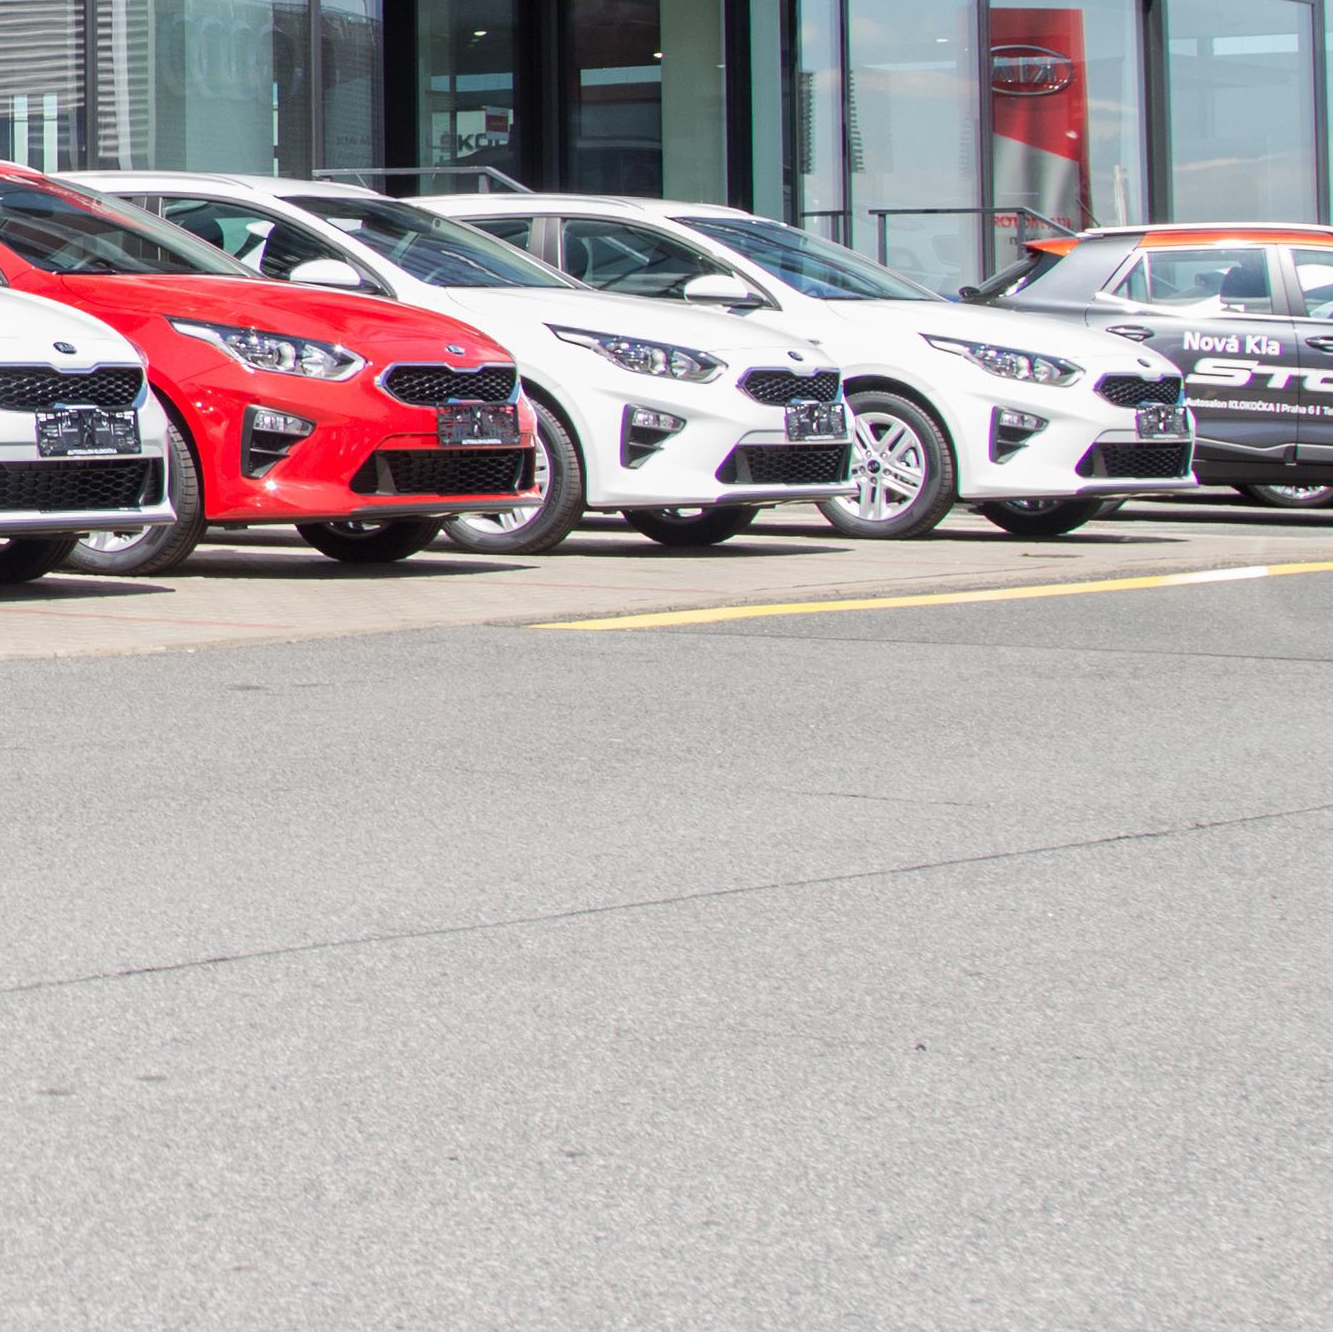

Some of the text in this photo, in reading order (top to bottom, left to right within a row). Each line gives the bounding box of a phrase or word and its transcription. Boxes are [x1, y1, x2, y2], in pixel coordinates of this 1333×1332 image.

[1183, 331, 1239, 353] Nová
[1185, 397, 1228, 410] Autosalon
[1228, 399, 1275, 413] KLOKOČKA
[1281, 403, 1307, 415] Praha
